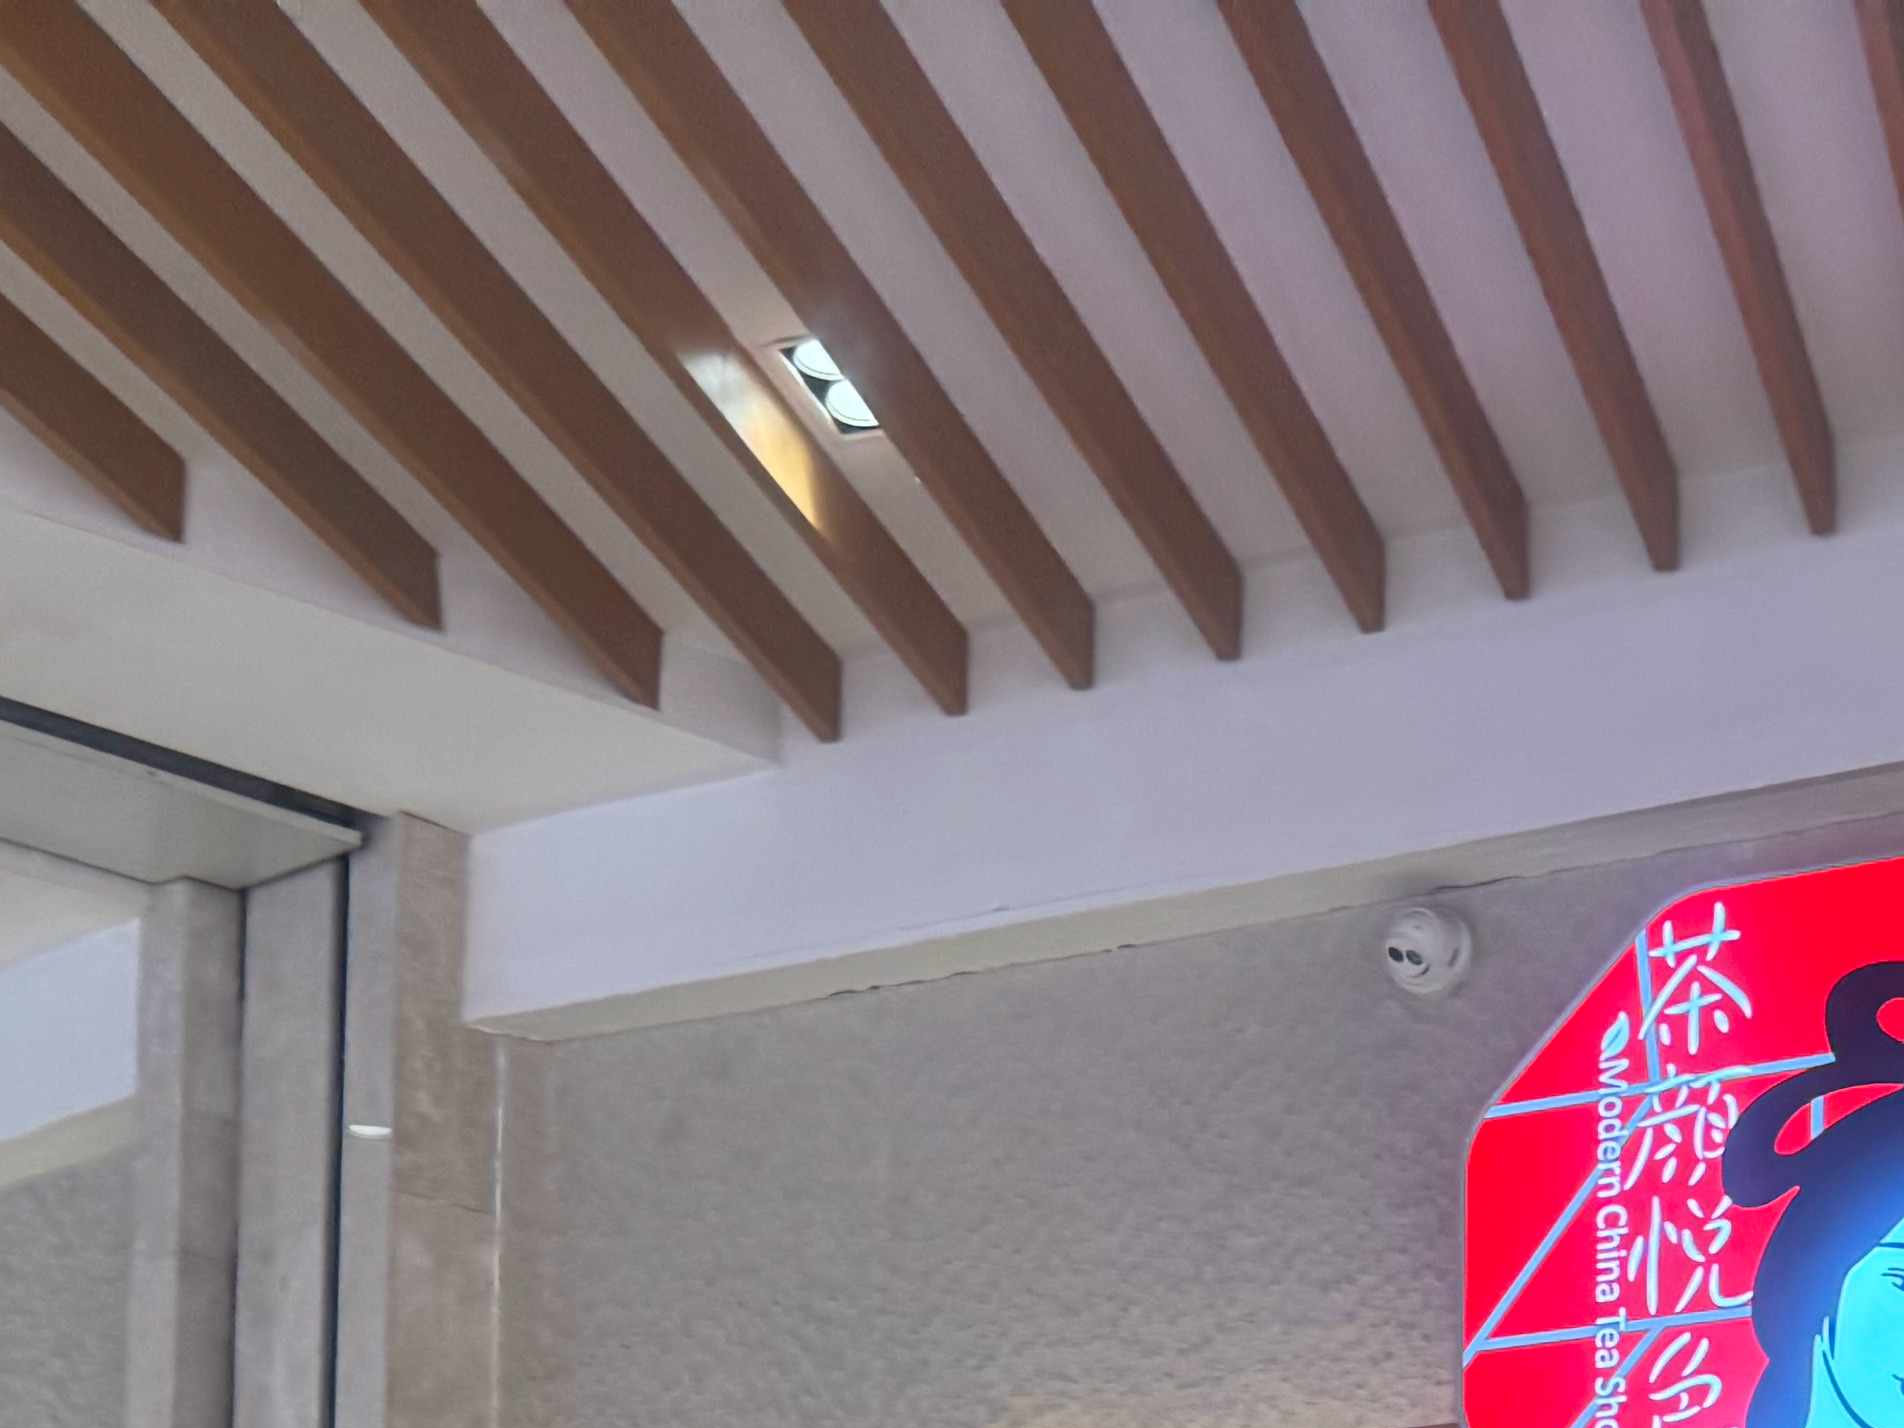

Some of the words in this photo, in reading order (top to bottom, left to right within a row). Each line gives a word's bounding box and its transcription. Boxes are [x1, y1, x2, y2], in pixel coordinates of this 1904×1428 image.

[1596, 1058, 1628, 1198] Modern
[1594, 1204, 1626, 1304] China
[1594, 1308, 1626, 1370] Tea
